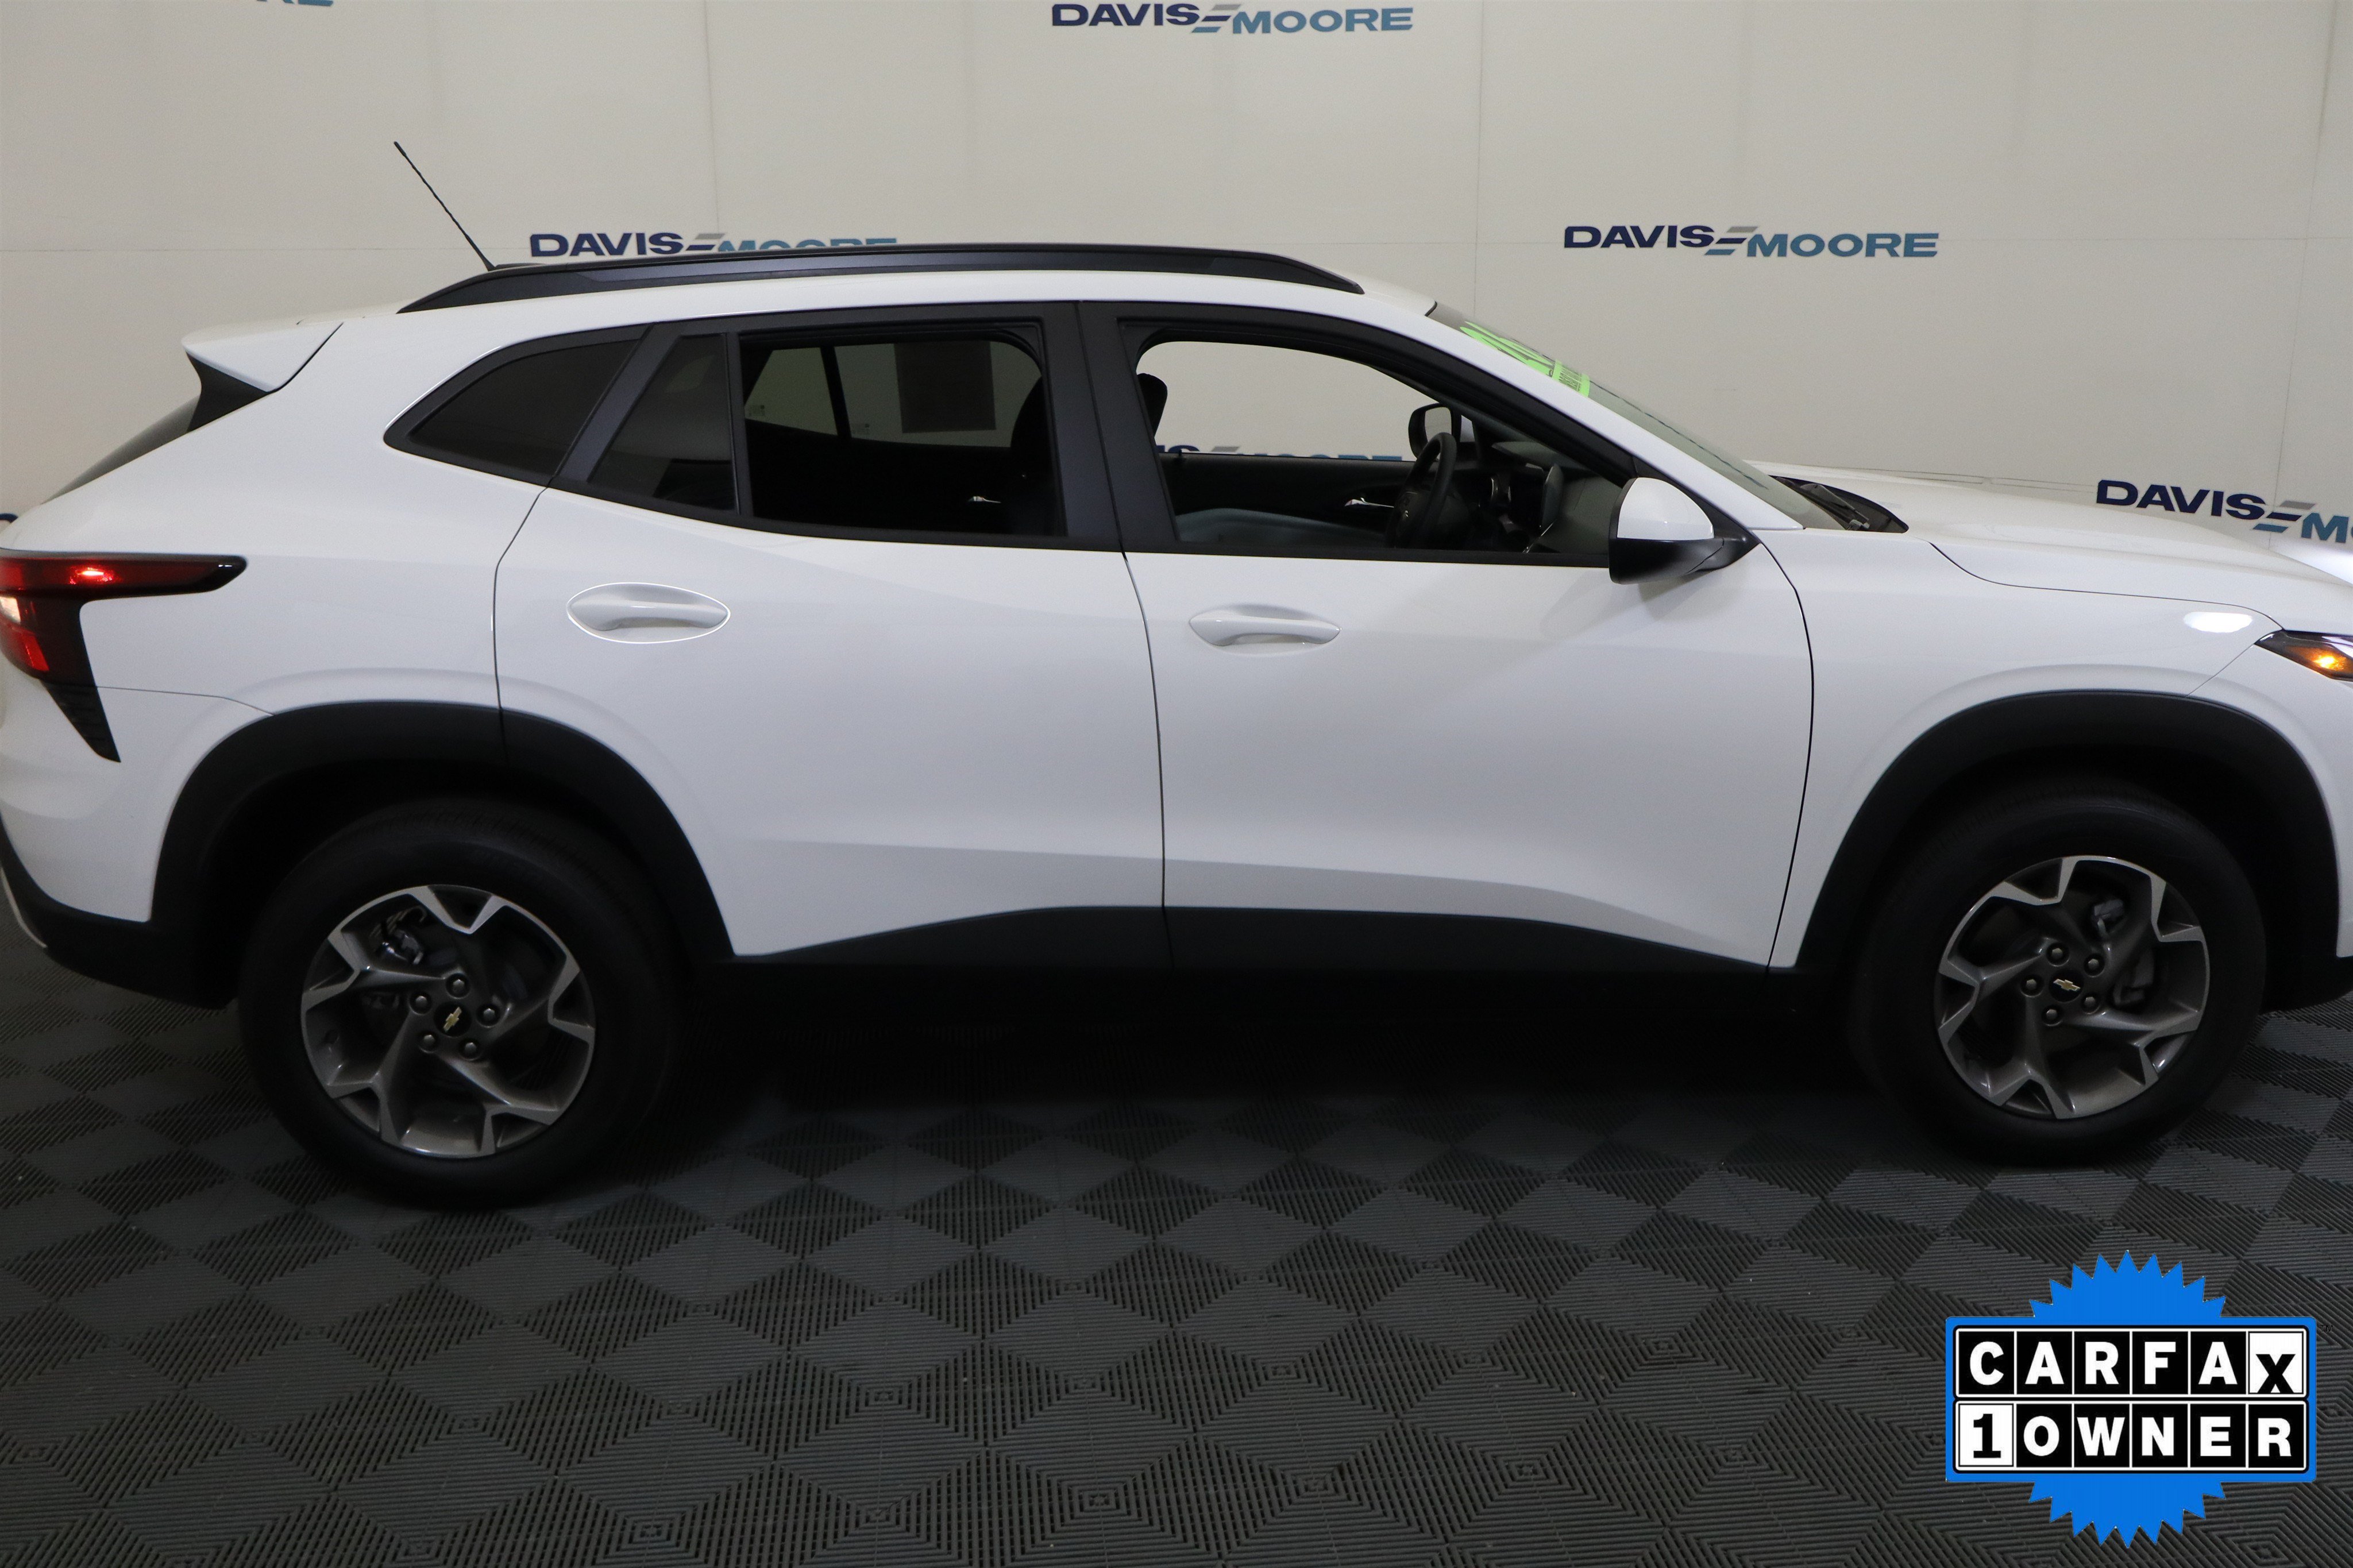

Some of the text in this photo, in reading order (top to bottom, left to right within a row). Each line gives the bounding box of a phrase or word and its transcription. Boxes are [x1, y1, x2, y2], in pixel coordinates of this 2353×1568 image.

[1052, 3, 1413, 34] DAVIS MOORE
[530, 232, 684, 257] DAVIS
[1564, 225, 1939, 257] DAVIS MOORE
[2096, 480, 2266, 520] DAVIS
